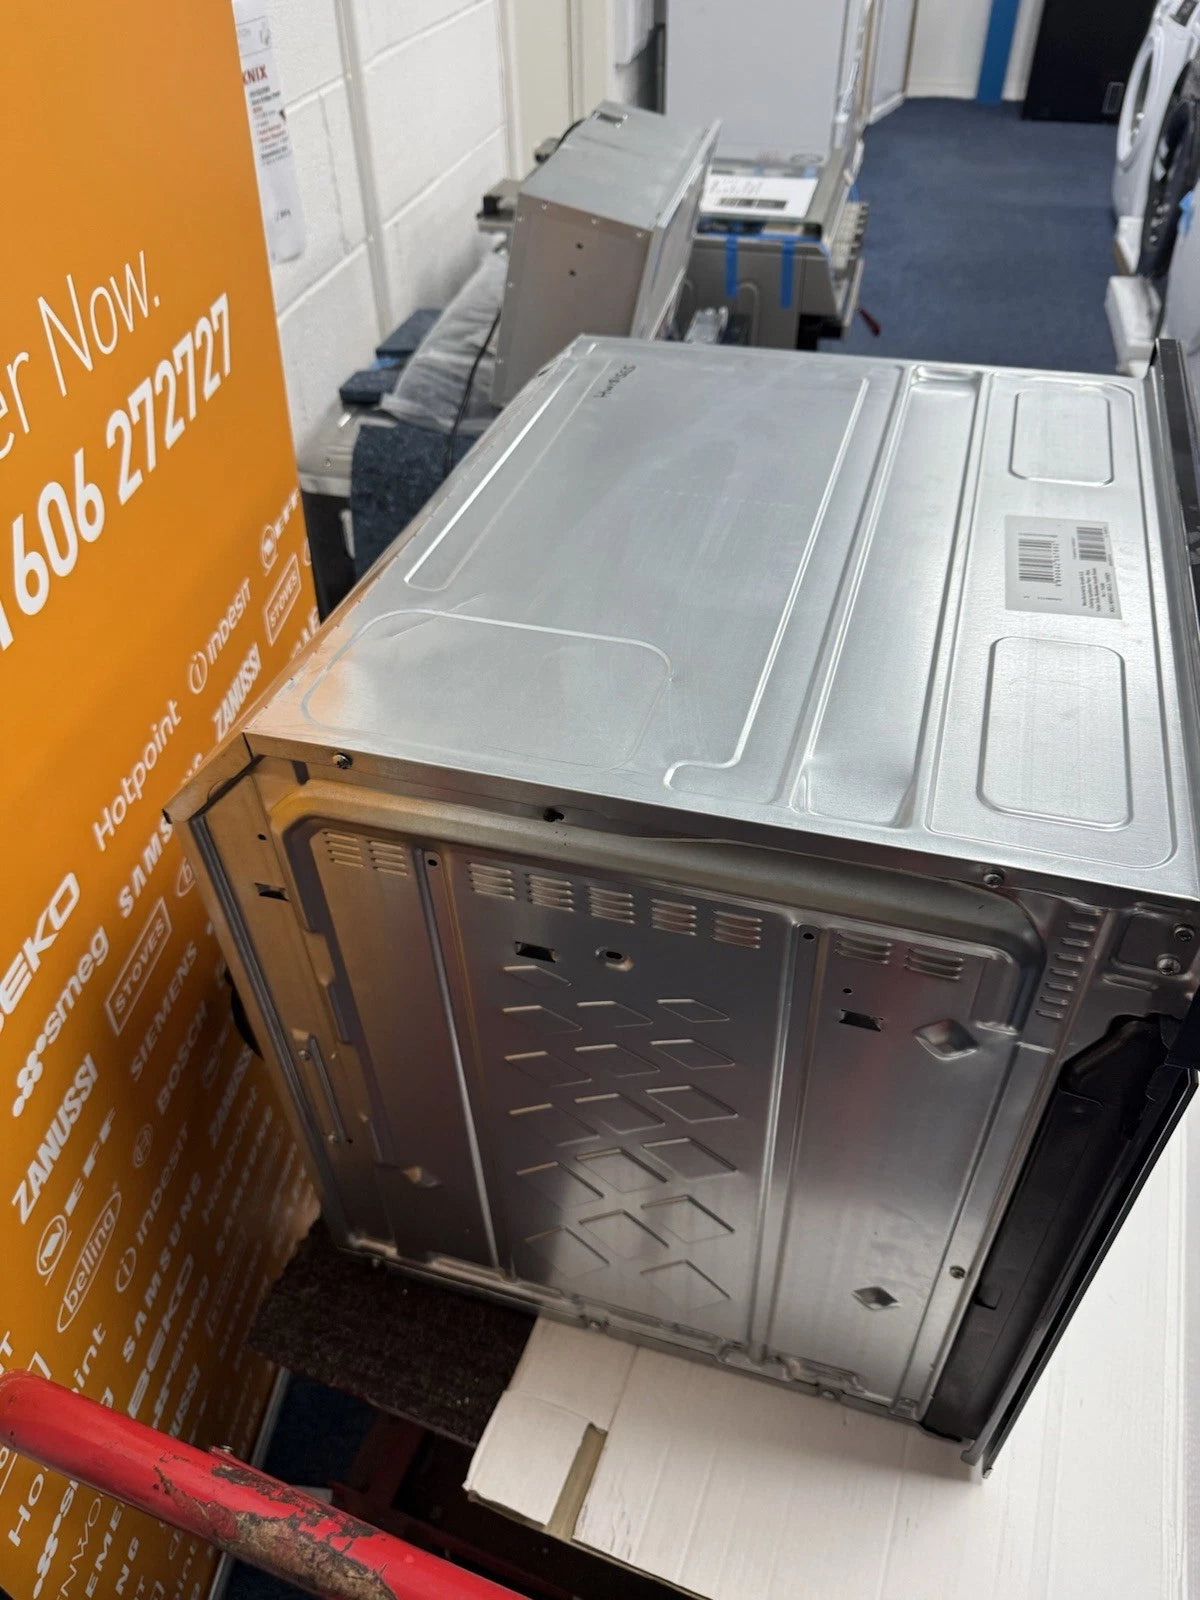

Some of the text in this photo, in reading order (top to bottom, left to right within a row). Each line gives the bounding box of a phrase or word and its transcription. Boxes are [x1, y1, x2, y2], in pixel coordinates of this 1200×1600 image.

[37, 249, 161, 397] Now.
[105, 292, 231, 506] 272727
[93, 700, 182, 852] Hotpoint
[0, 872, 80, 1035] EKO
[46, 926, 109, 1045] smeg
[115, 917, 166, 1014] STOVES
[131, 940, 197, 1082] SIEMENS
[156, 1000, 208, 1116] BOSCH
[11, 1052, 99, 1225] ZANUSSI
[62, 1206, 116, 1314] belling
[122, 1171, 201, 1363] SAMSUNG
